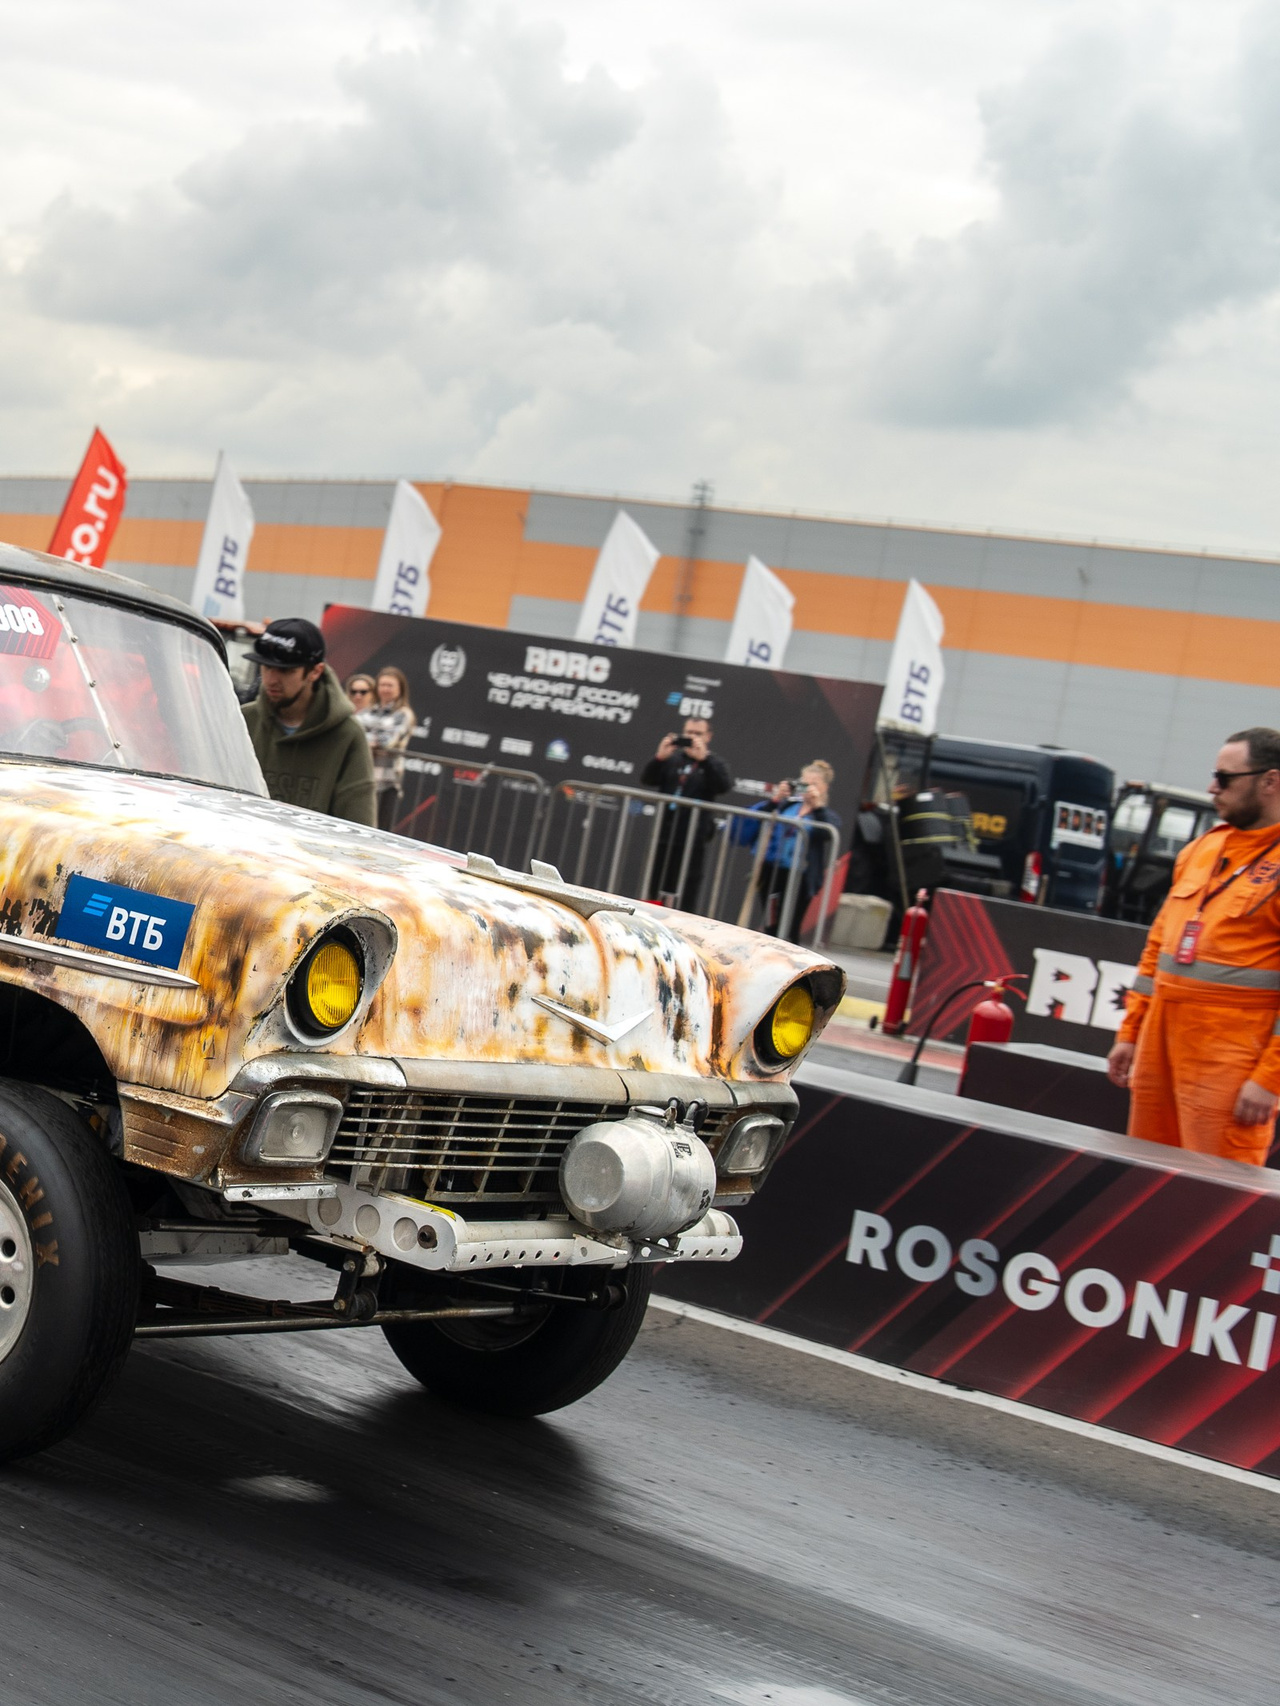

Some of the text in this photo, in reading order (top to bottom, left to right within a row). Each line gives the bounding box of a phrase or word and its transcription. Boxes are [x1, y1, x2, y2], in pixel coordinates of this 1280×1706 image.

[524, 645, 611, 683] RDRC
[679, 696, 714, 720] ВТБ
[900, 660, 931, 724] ВТБ
[106, 906, 167, 951] ВТБ
[845, 1209, 1277, 1373] ROSGONKI
